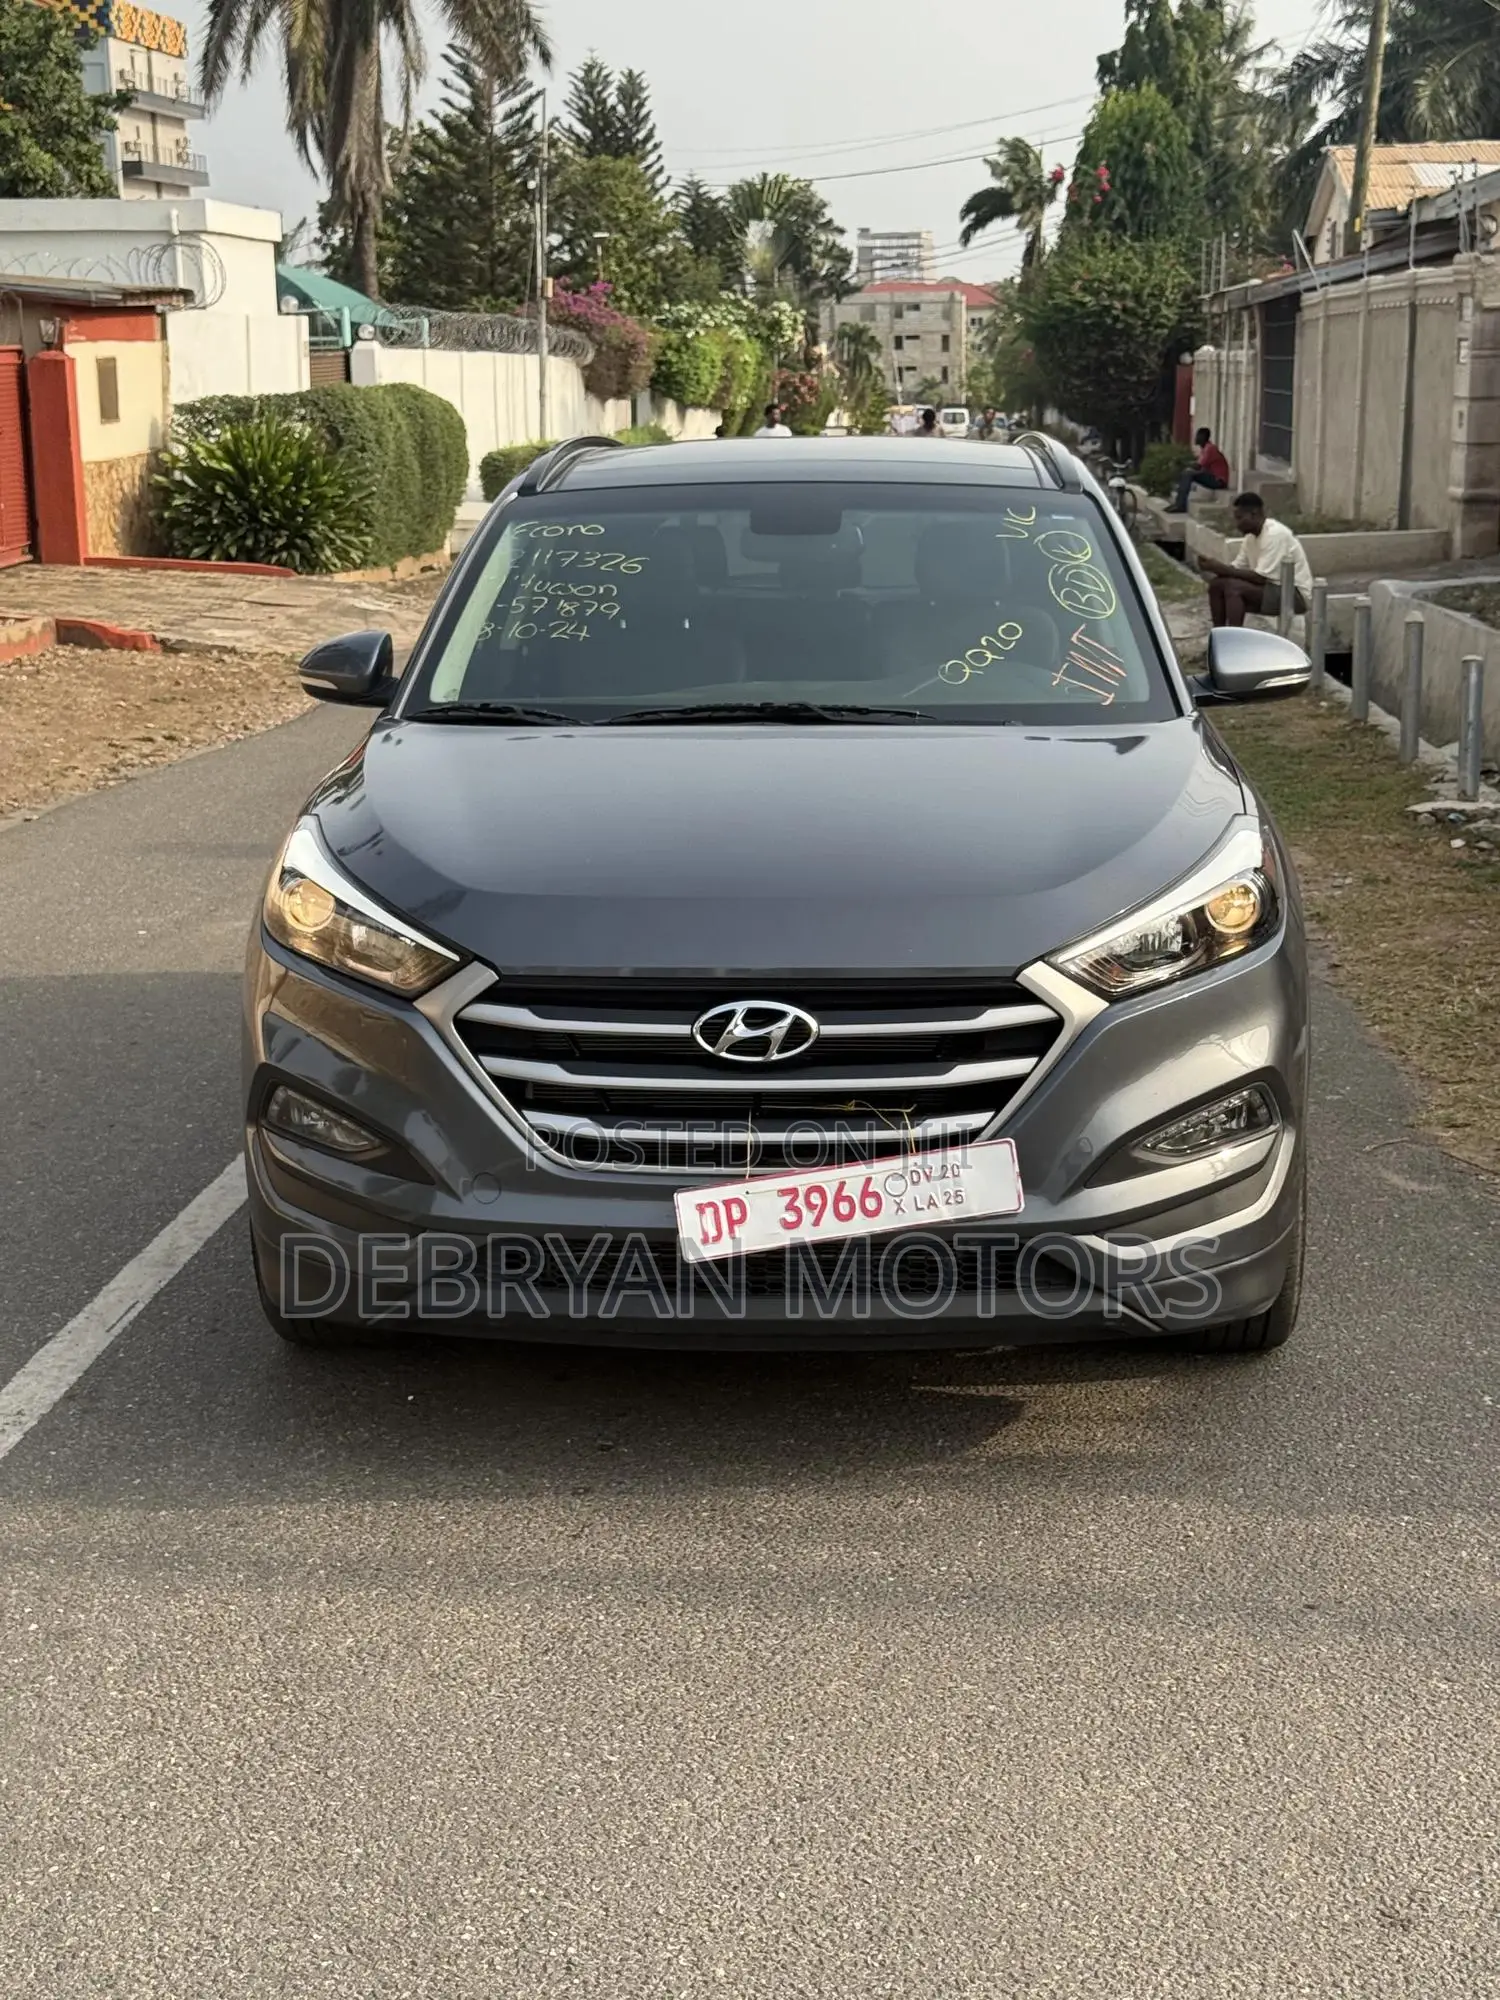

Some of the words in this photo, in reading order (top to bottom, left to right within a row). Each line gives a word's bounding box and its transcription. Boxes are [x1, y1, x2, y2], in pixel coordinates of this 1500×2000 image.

[909, 1165, 933, 1187] DV
[940, 1163, 961, 1179] 20
[694, 1196, 749, 1246] DP
[777, 1176, 885, 1231] 3966
[913, 1193, 940, 1212] LA
[943, 1189, 965, 1206] 25
